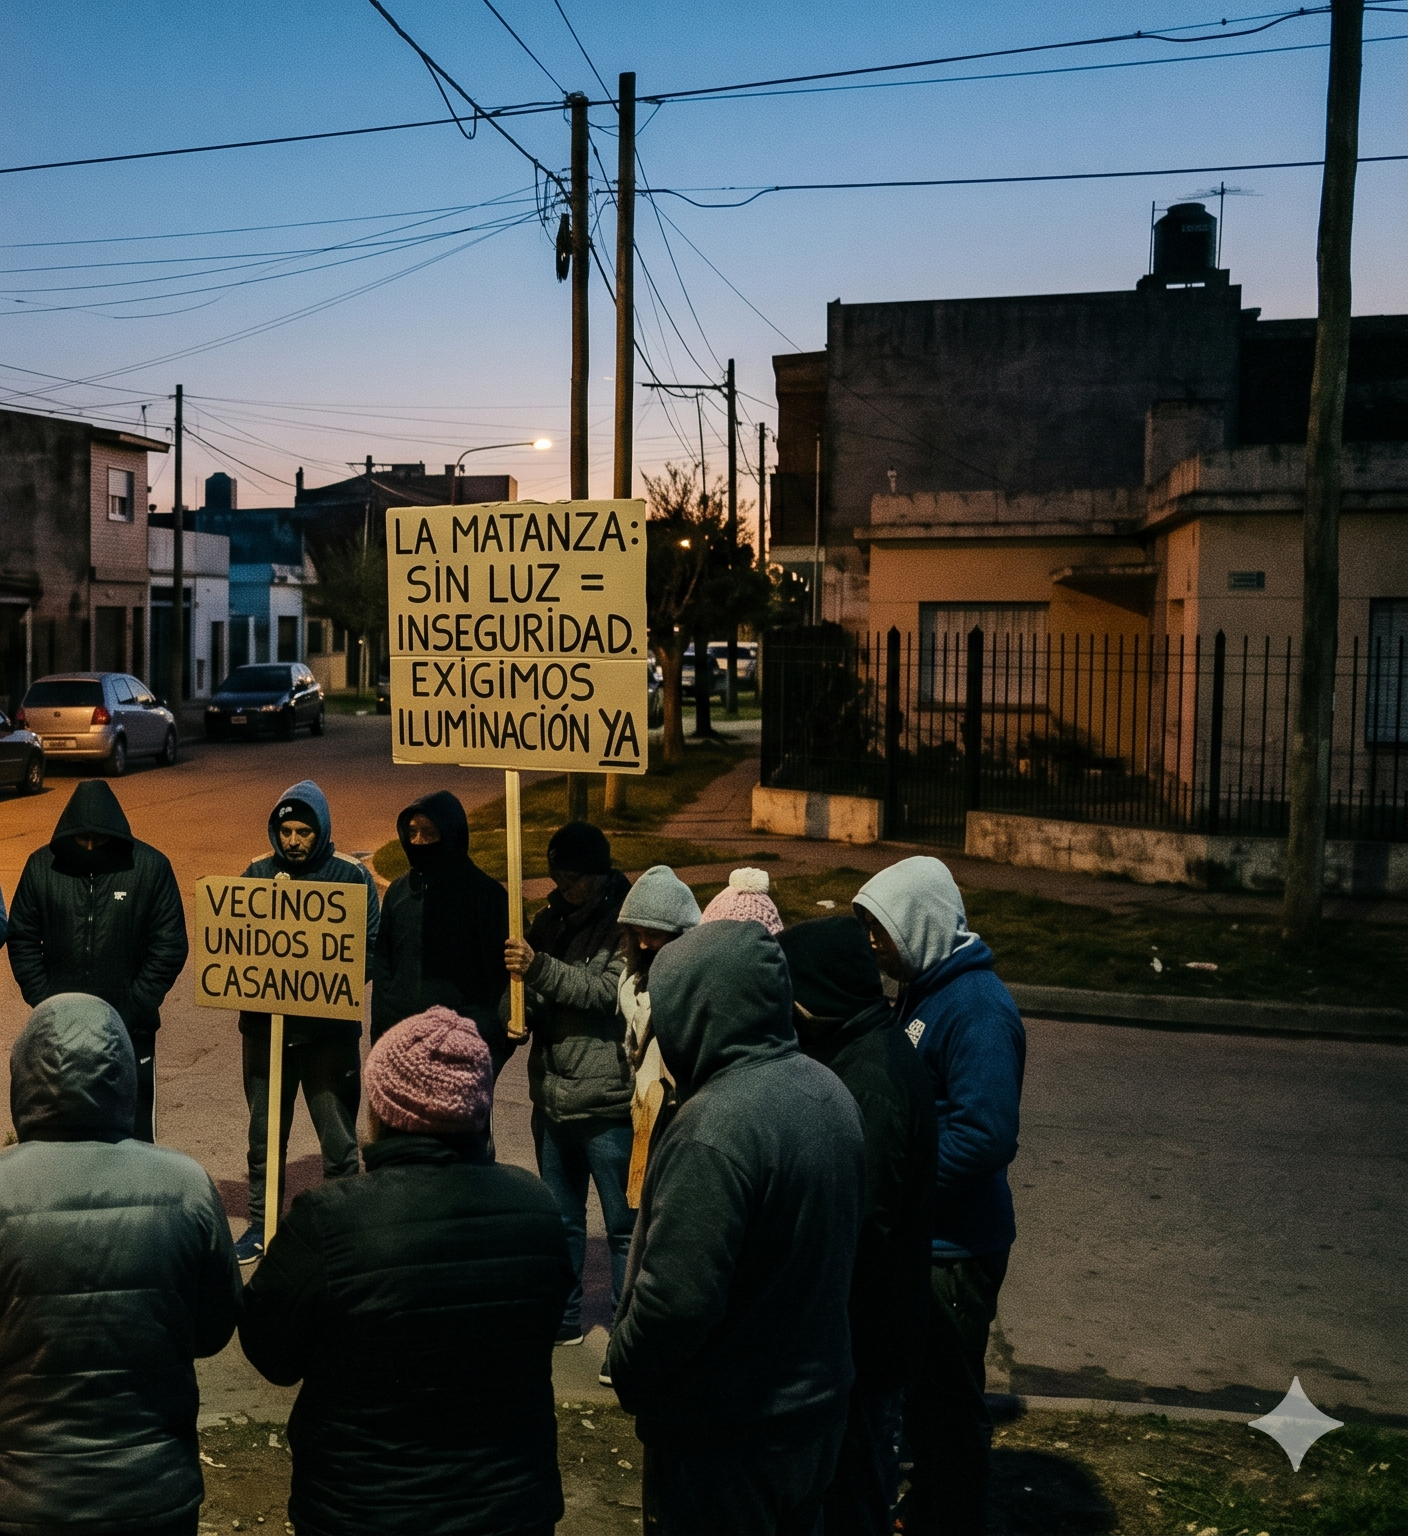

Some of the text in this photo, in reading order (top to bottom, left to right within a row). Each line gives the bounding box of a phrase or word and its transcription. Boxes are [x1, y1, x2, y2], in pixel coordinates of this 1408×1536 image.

[395, 511, 639, 554] LA MATANZA:
[407, 559, 604, 603] SIN LUZ =
[398, 607, 638, 654] INSEGURIDAD.
[412, 656, 594, 701] EXIGIMOS
[399, 703, 640, 758] ILUMINACIÓN YA
[206, 882, 347, 923] VECINOS
[205, 924, 355, 962] UNIDOS DE
[201, 963, 360, 1007] CASANOVA.
